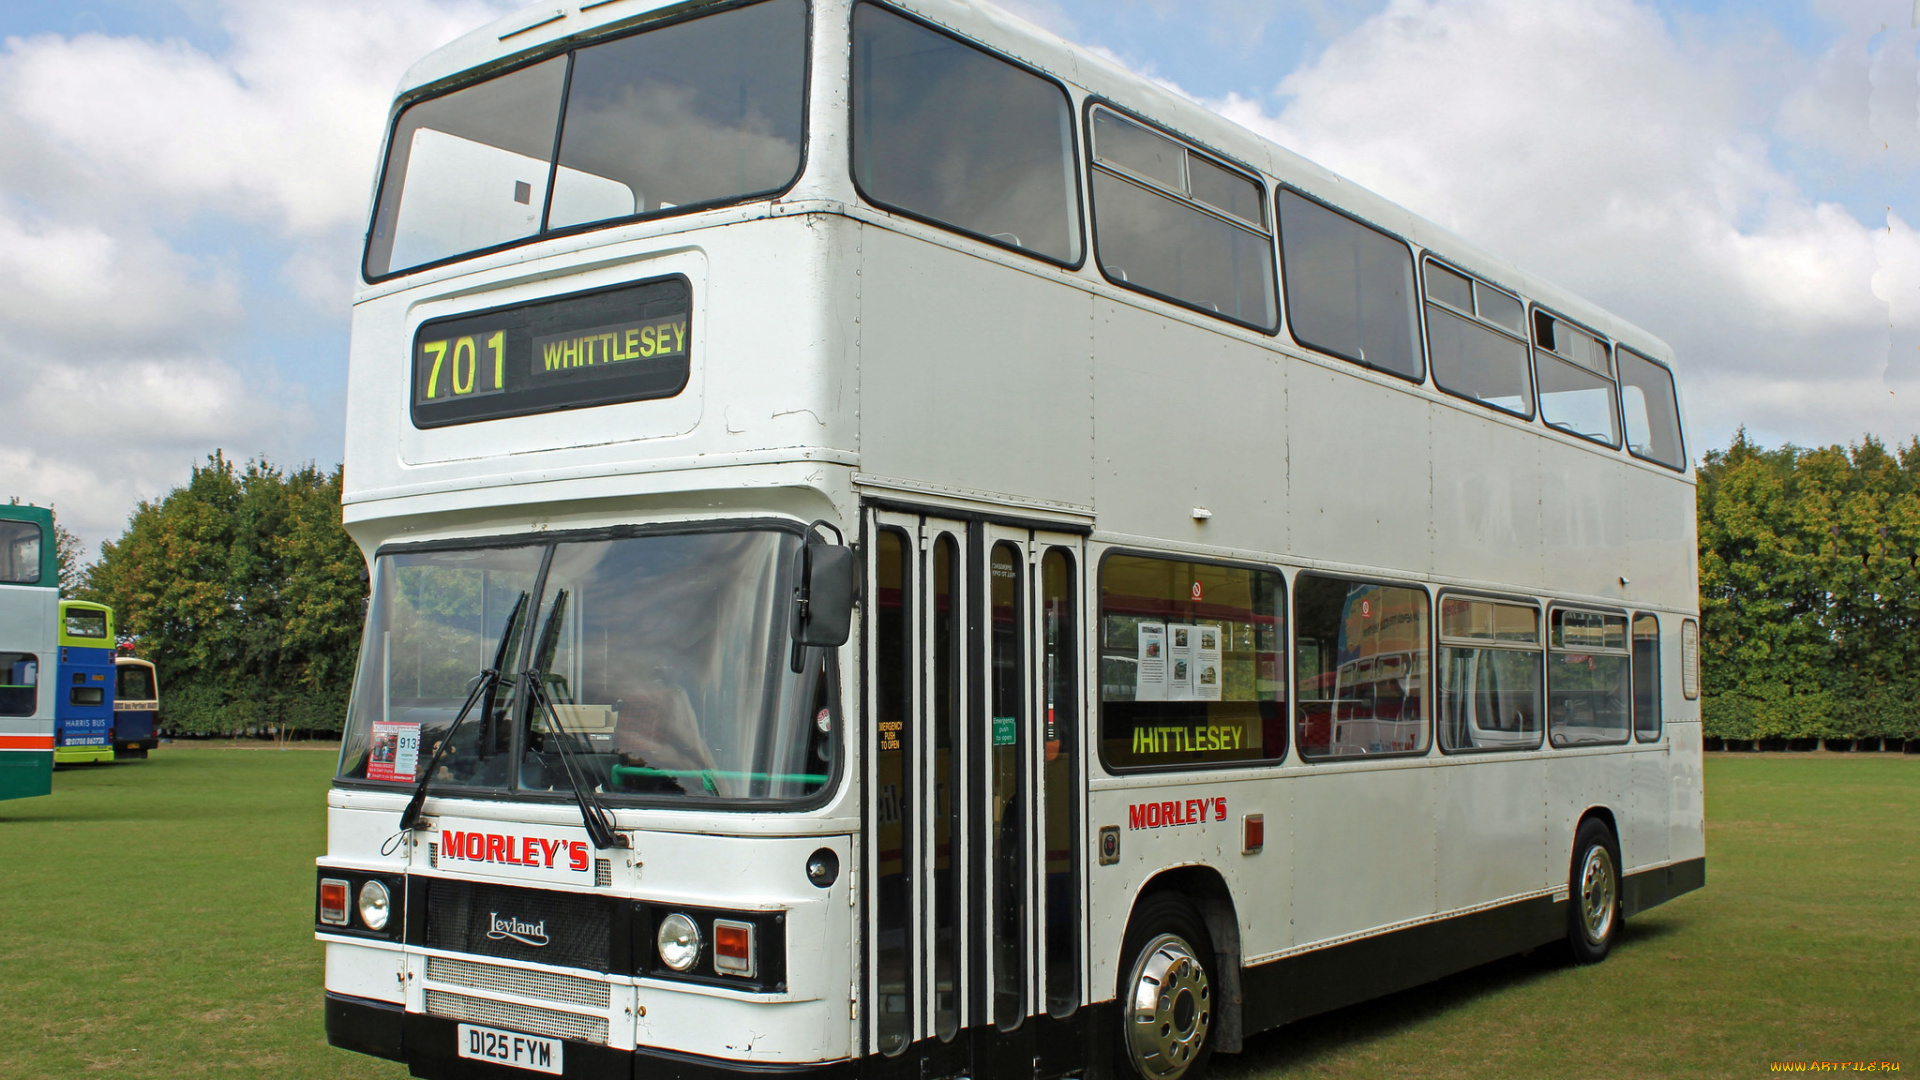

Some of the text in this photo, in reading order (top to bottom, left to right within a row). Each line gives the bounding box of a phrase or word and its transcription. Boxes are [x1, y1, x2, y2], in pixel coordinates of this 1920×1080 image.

[424, 321, 686, 399] 701 WHITTLESEY
[65, 719, 105, 727] HARRIS BUS
[884, 731, 896, 741] PUSH
[400, 737, 417, 749] 913
[881, 739, 900, 750] TO OPEN
[1132, 726, 1243, 754] HITTLESEY
[1128, 797, 1227, 831] MORLEY'S
[441, 830, 589, 872] MORLEY'S
[486, 911, 550, 946] Leyland
[470, 1030, 551, 1068] D125 FYM
